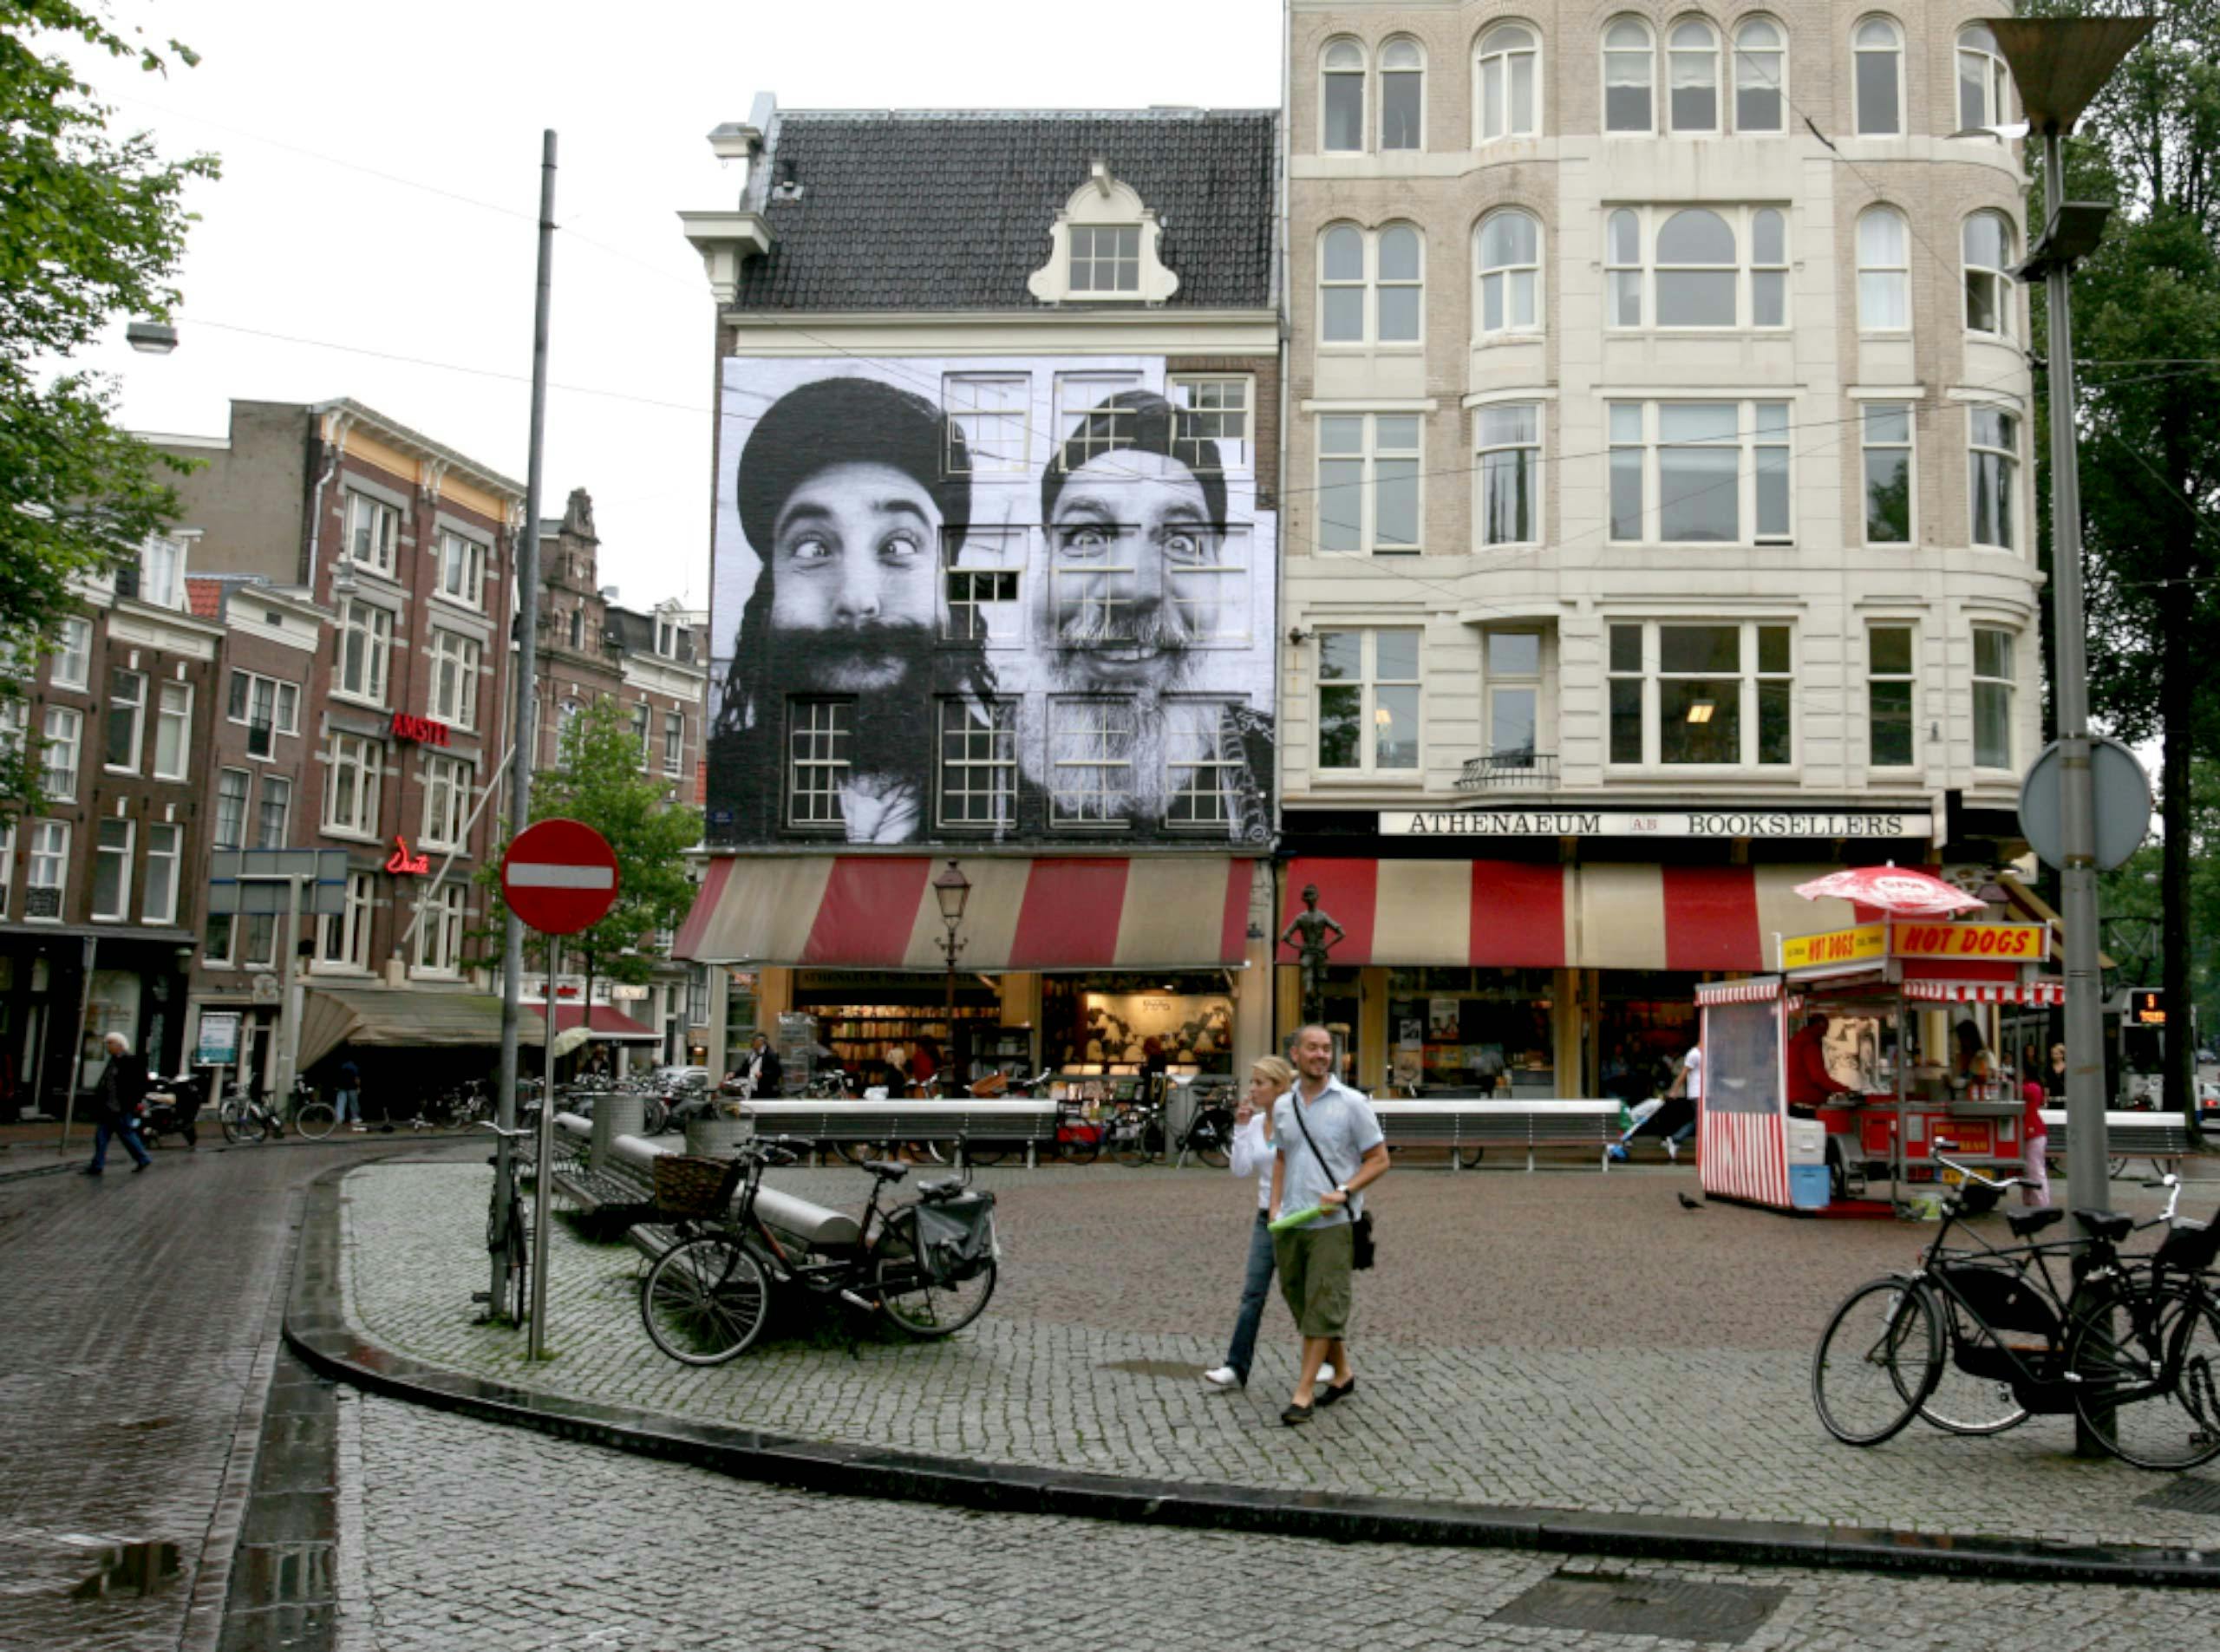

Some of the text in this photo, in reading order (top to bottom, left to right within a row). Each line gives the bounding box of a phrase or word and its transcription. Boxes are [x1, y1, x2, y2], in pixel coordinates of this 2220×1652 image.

[1408, 813, 1602, 834] ATHENAEUM
[1688, 814, 1903, 835] BOOKSELLERS
[1808, 937, 1825, 962] HOT
[1828, 932, 1854, 958] DOGS
[1903, 928, 1953, 951] HOT
[1960, 929, 2030, 953] DOGS
